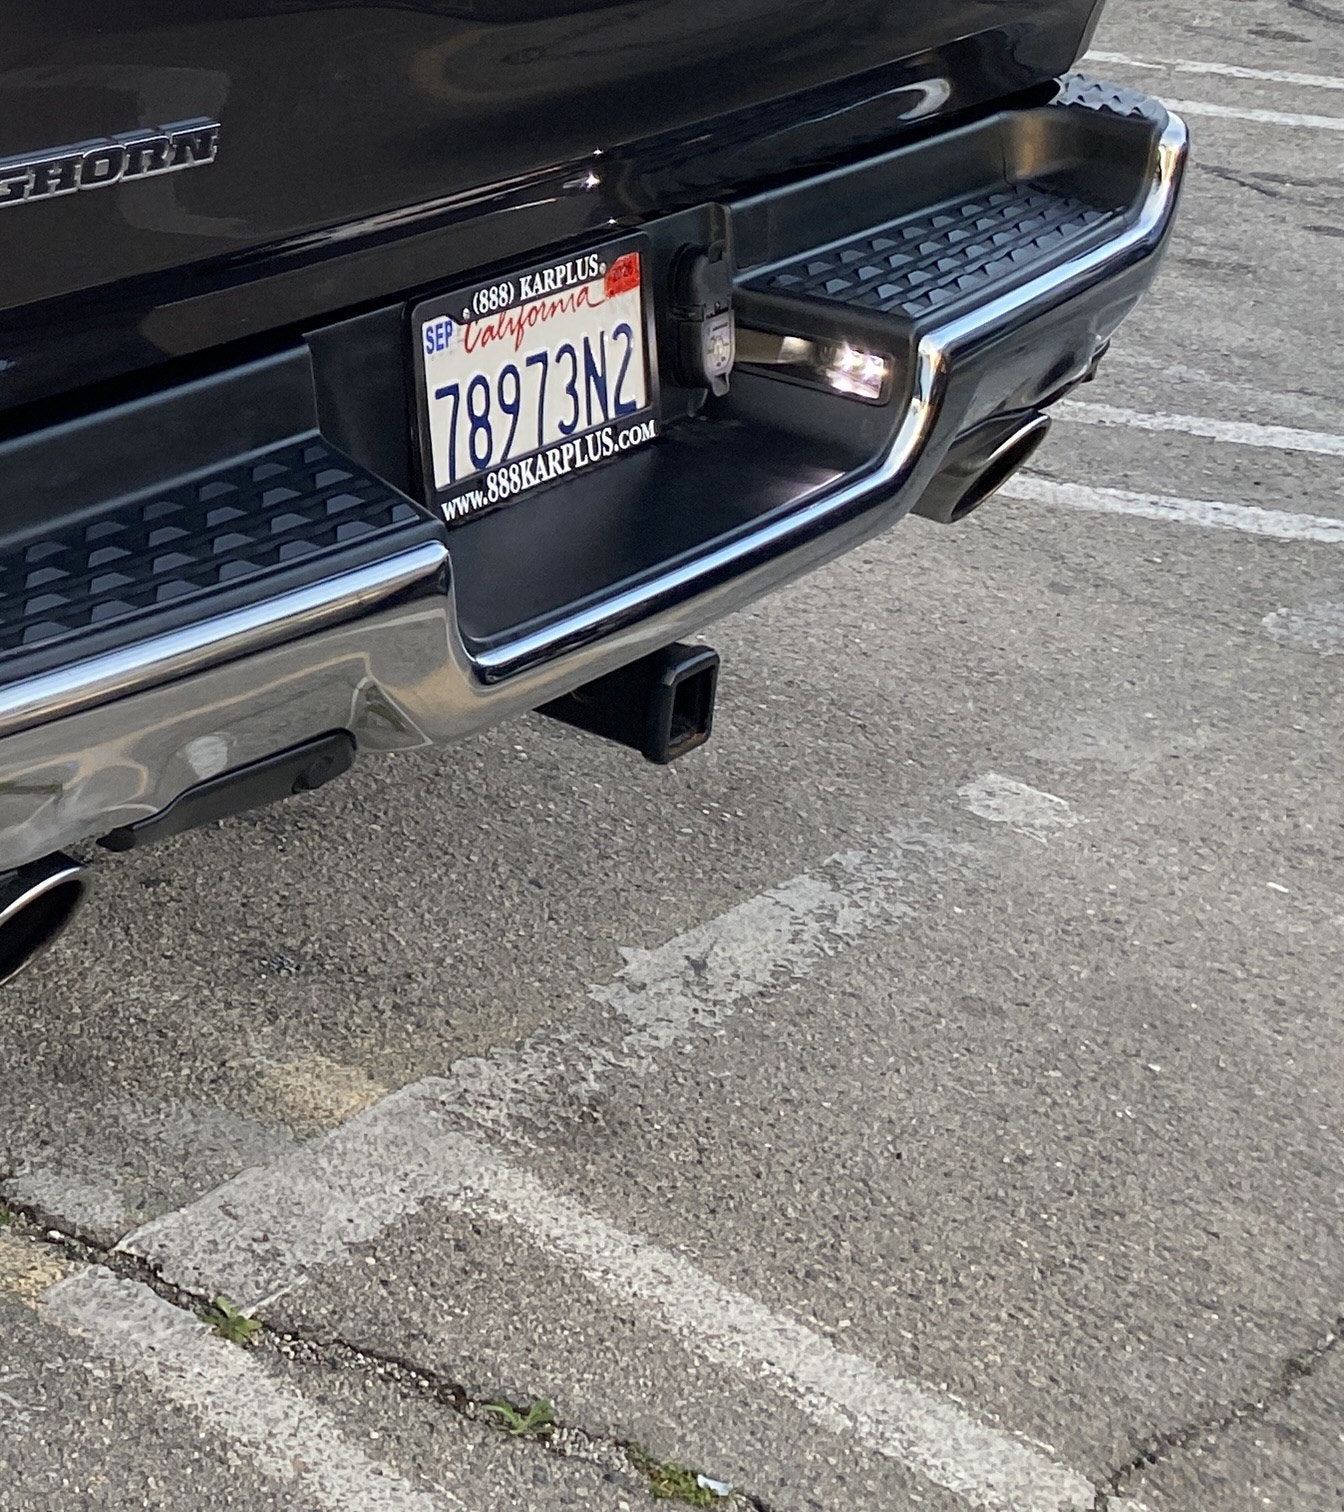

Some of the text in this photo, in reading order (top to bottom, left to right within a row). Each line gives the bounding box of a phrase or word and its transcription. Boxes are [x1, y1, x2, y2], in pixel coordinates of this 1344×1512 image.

[472, 253, 599, 315] (888) KARPLUS
[425, 319, 453, 355] SEP
[464, 285, 606, 354] California
[435, 322, 637, 486] 78973N2
